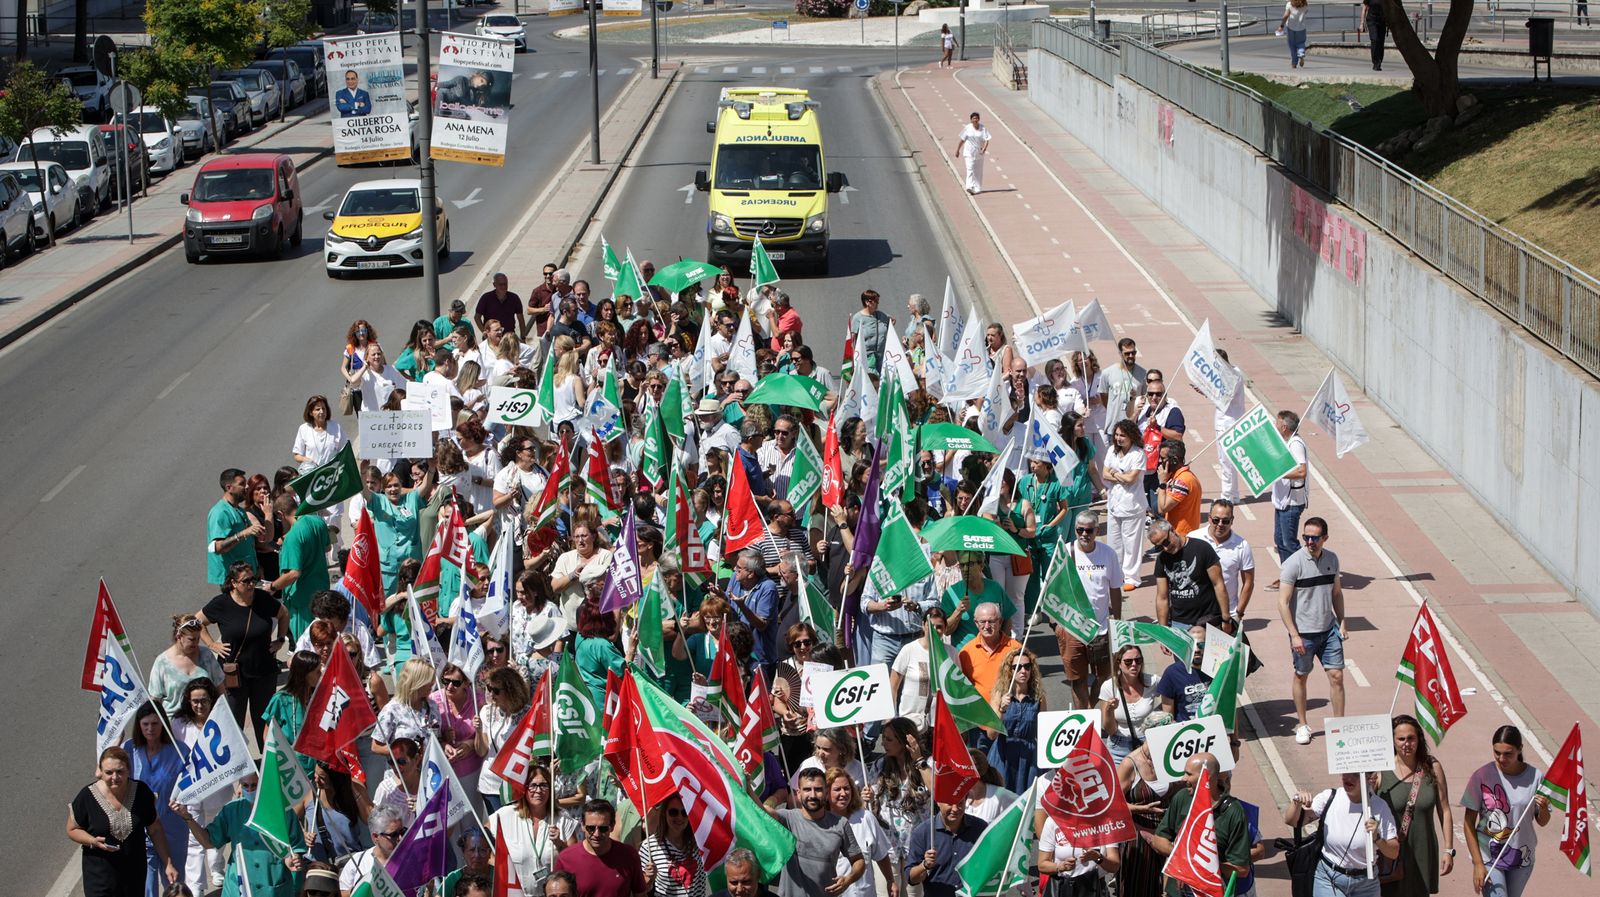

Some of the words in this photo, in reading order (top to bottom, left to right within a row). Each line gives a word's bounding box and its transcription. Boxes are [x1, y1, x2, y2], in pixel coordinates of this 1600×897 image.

[366, 39, 389, 47] PEPE
[481, 41, 503, 51] PEPE
[345, 45, 399, 57] FESTIVAL
[460, 46, 511, 59] FESTIVAL
[453, 58, 502, 68] tiopepefestival.com
[347, 115, 393, 128] GILBERTO
[341, 127, 373, 137] SANTA
[374, 124, 402, 134] ROSA
[444, 122, 465, 132] ANA
[467, 125, 495, 136] MENA
[341, 222, 408, 230] PROSEGUR
[1223, 408, 1268, 447] CÁDIZ
[1232, 445, 1266, 490] SATSE
[962, 534, 994, 543] SATSE
[963, 539, 995, 549] Cádiz
[1045, 592, 1096, 638] SATSE
[1347, 735, 1388, 747] CONTRATOS
[1066, 753, 1110, 805] UGT
[1072, 818, 1126, 840] www.ugt.es
